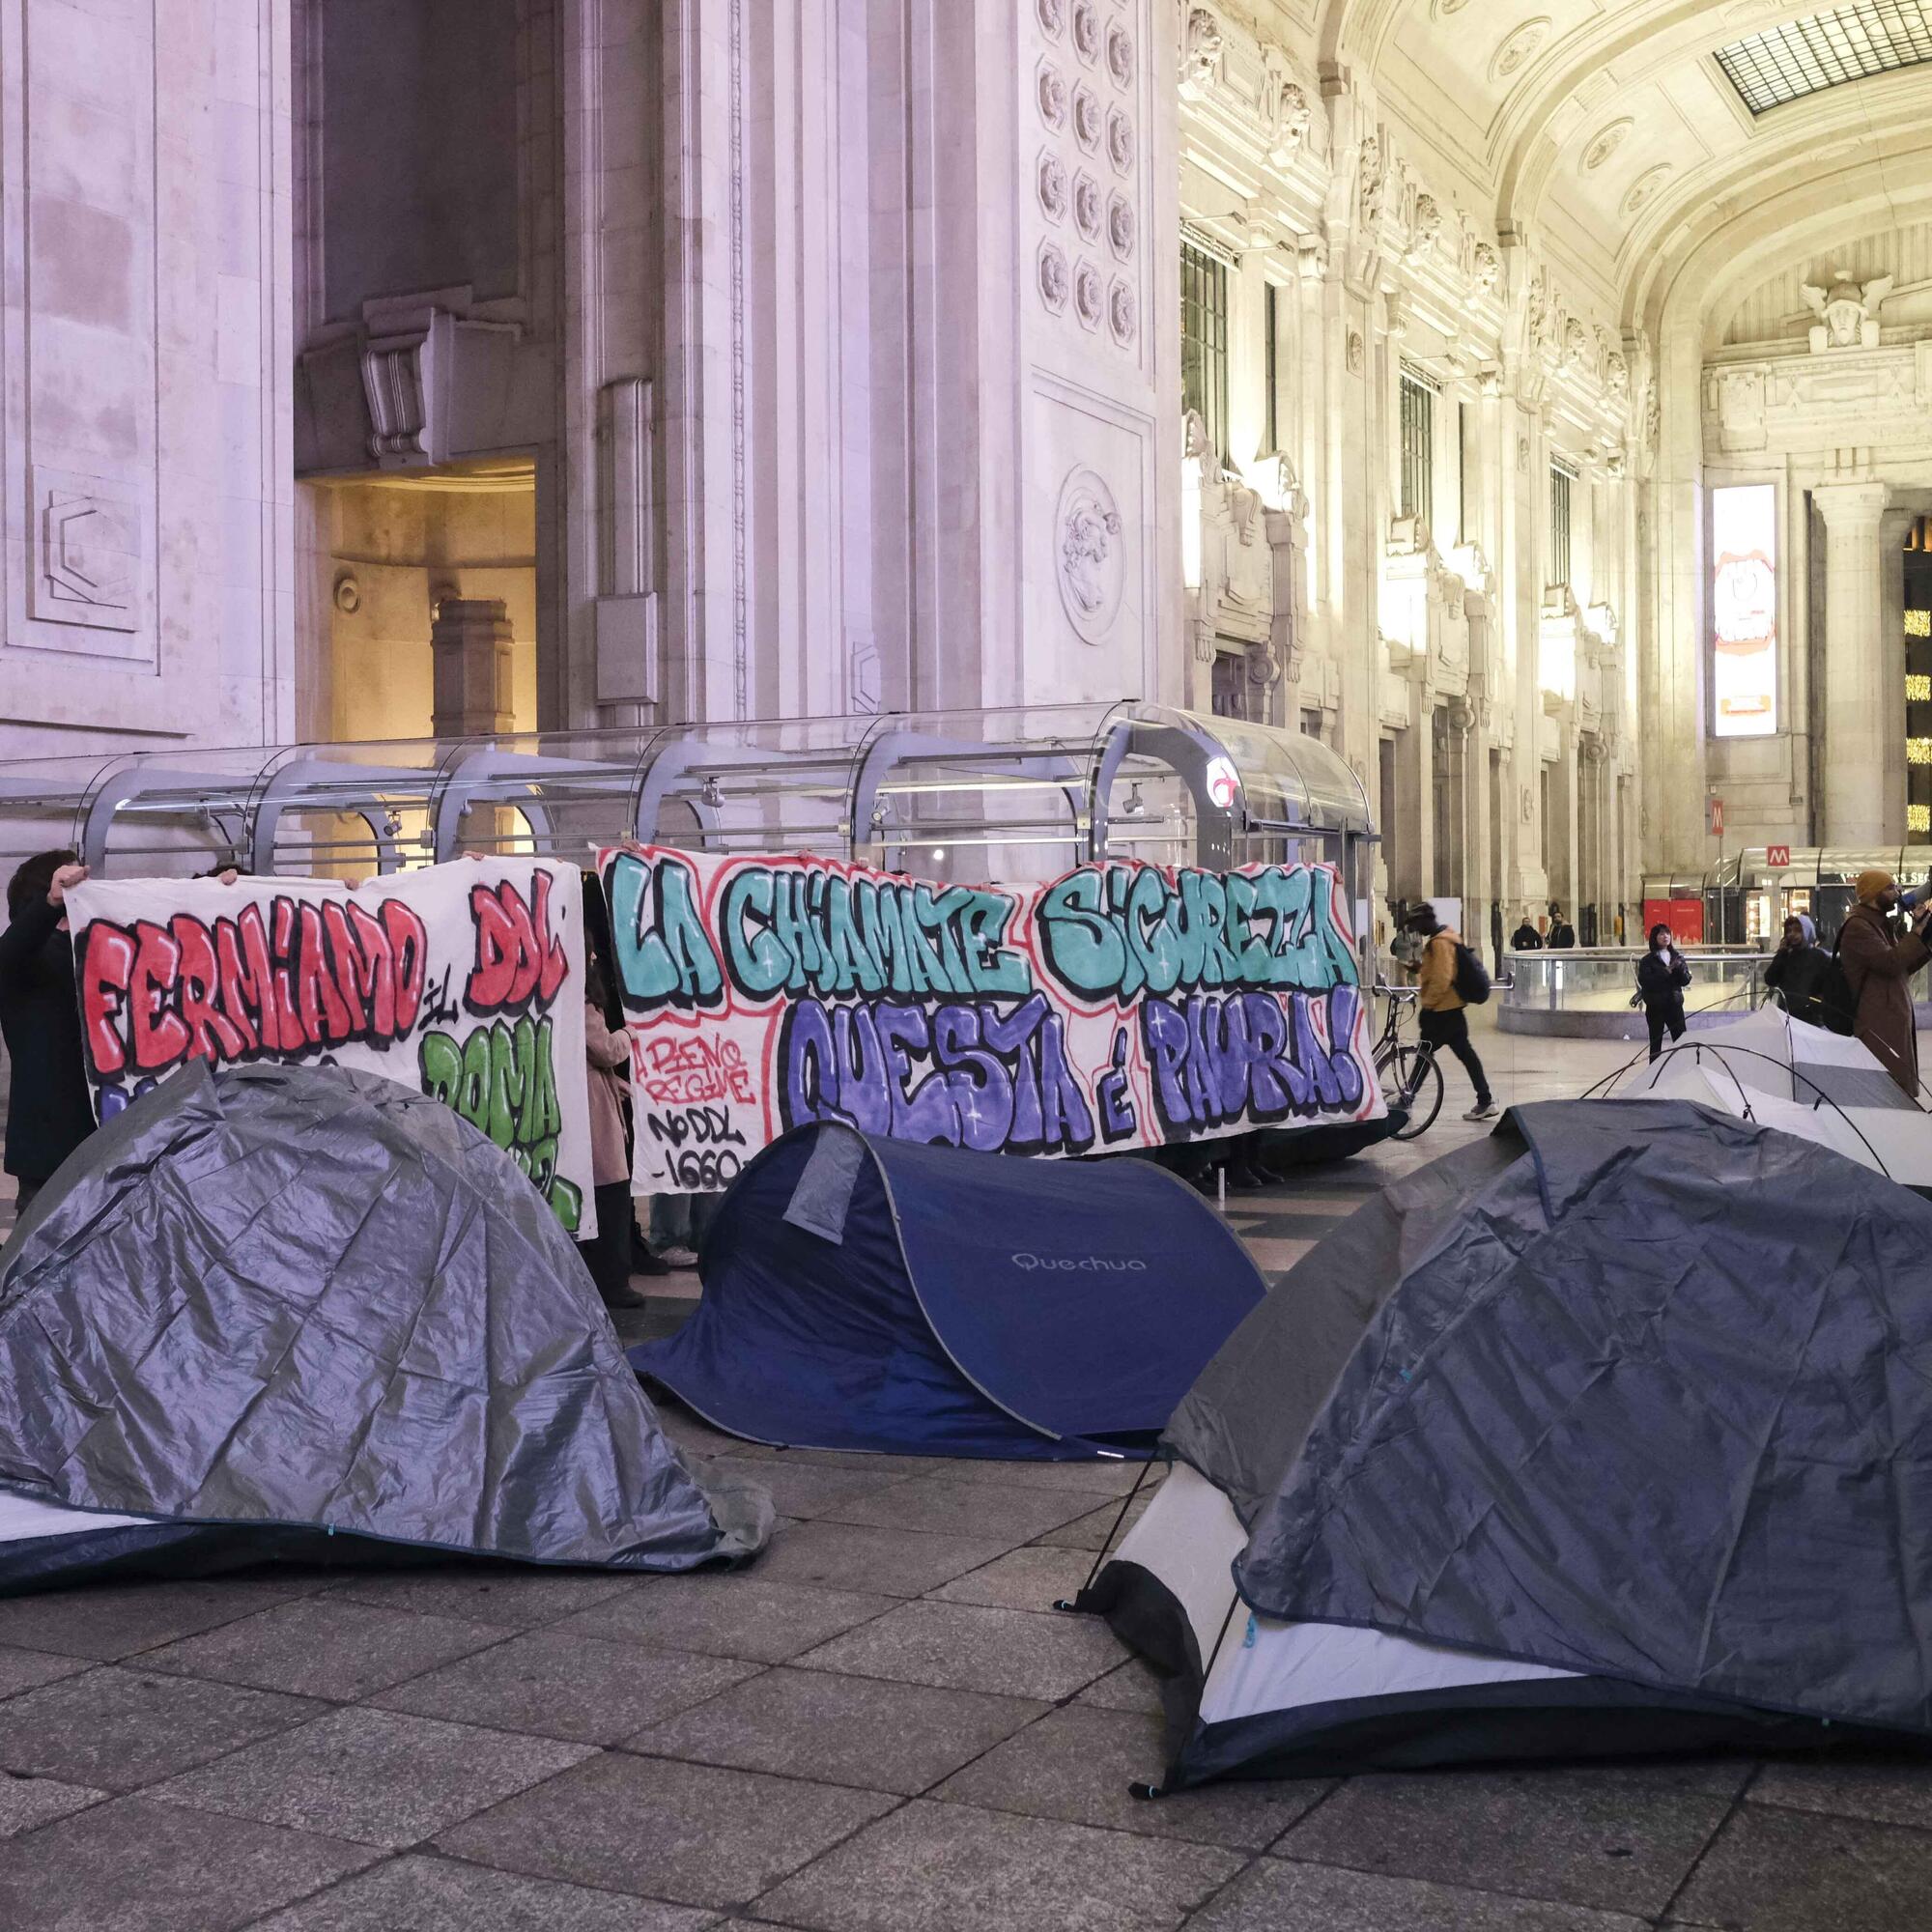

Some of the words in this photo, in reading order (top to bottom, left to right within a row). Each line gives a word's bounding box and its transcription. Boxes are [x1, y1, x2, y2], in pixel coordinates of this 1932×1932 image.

[1713, 806, 1723, 828] M
[1769, 848, 1789, 864] M
[463, 867, 570, 1017] DDL
[603, 851, 724, 1013] LA
[778, 989, 1094, 1156] QUESTA
[1139, 983, 1364, 1144] PAURA!
[686, 1104, 747, 1146] DDL
[1011, 1253, 1147, 1271] Quechua
